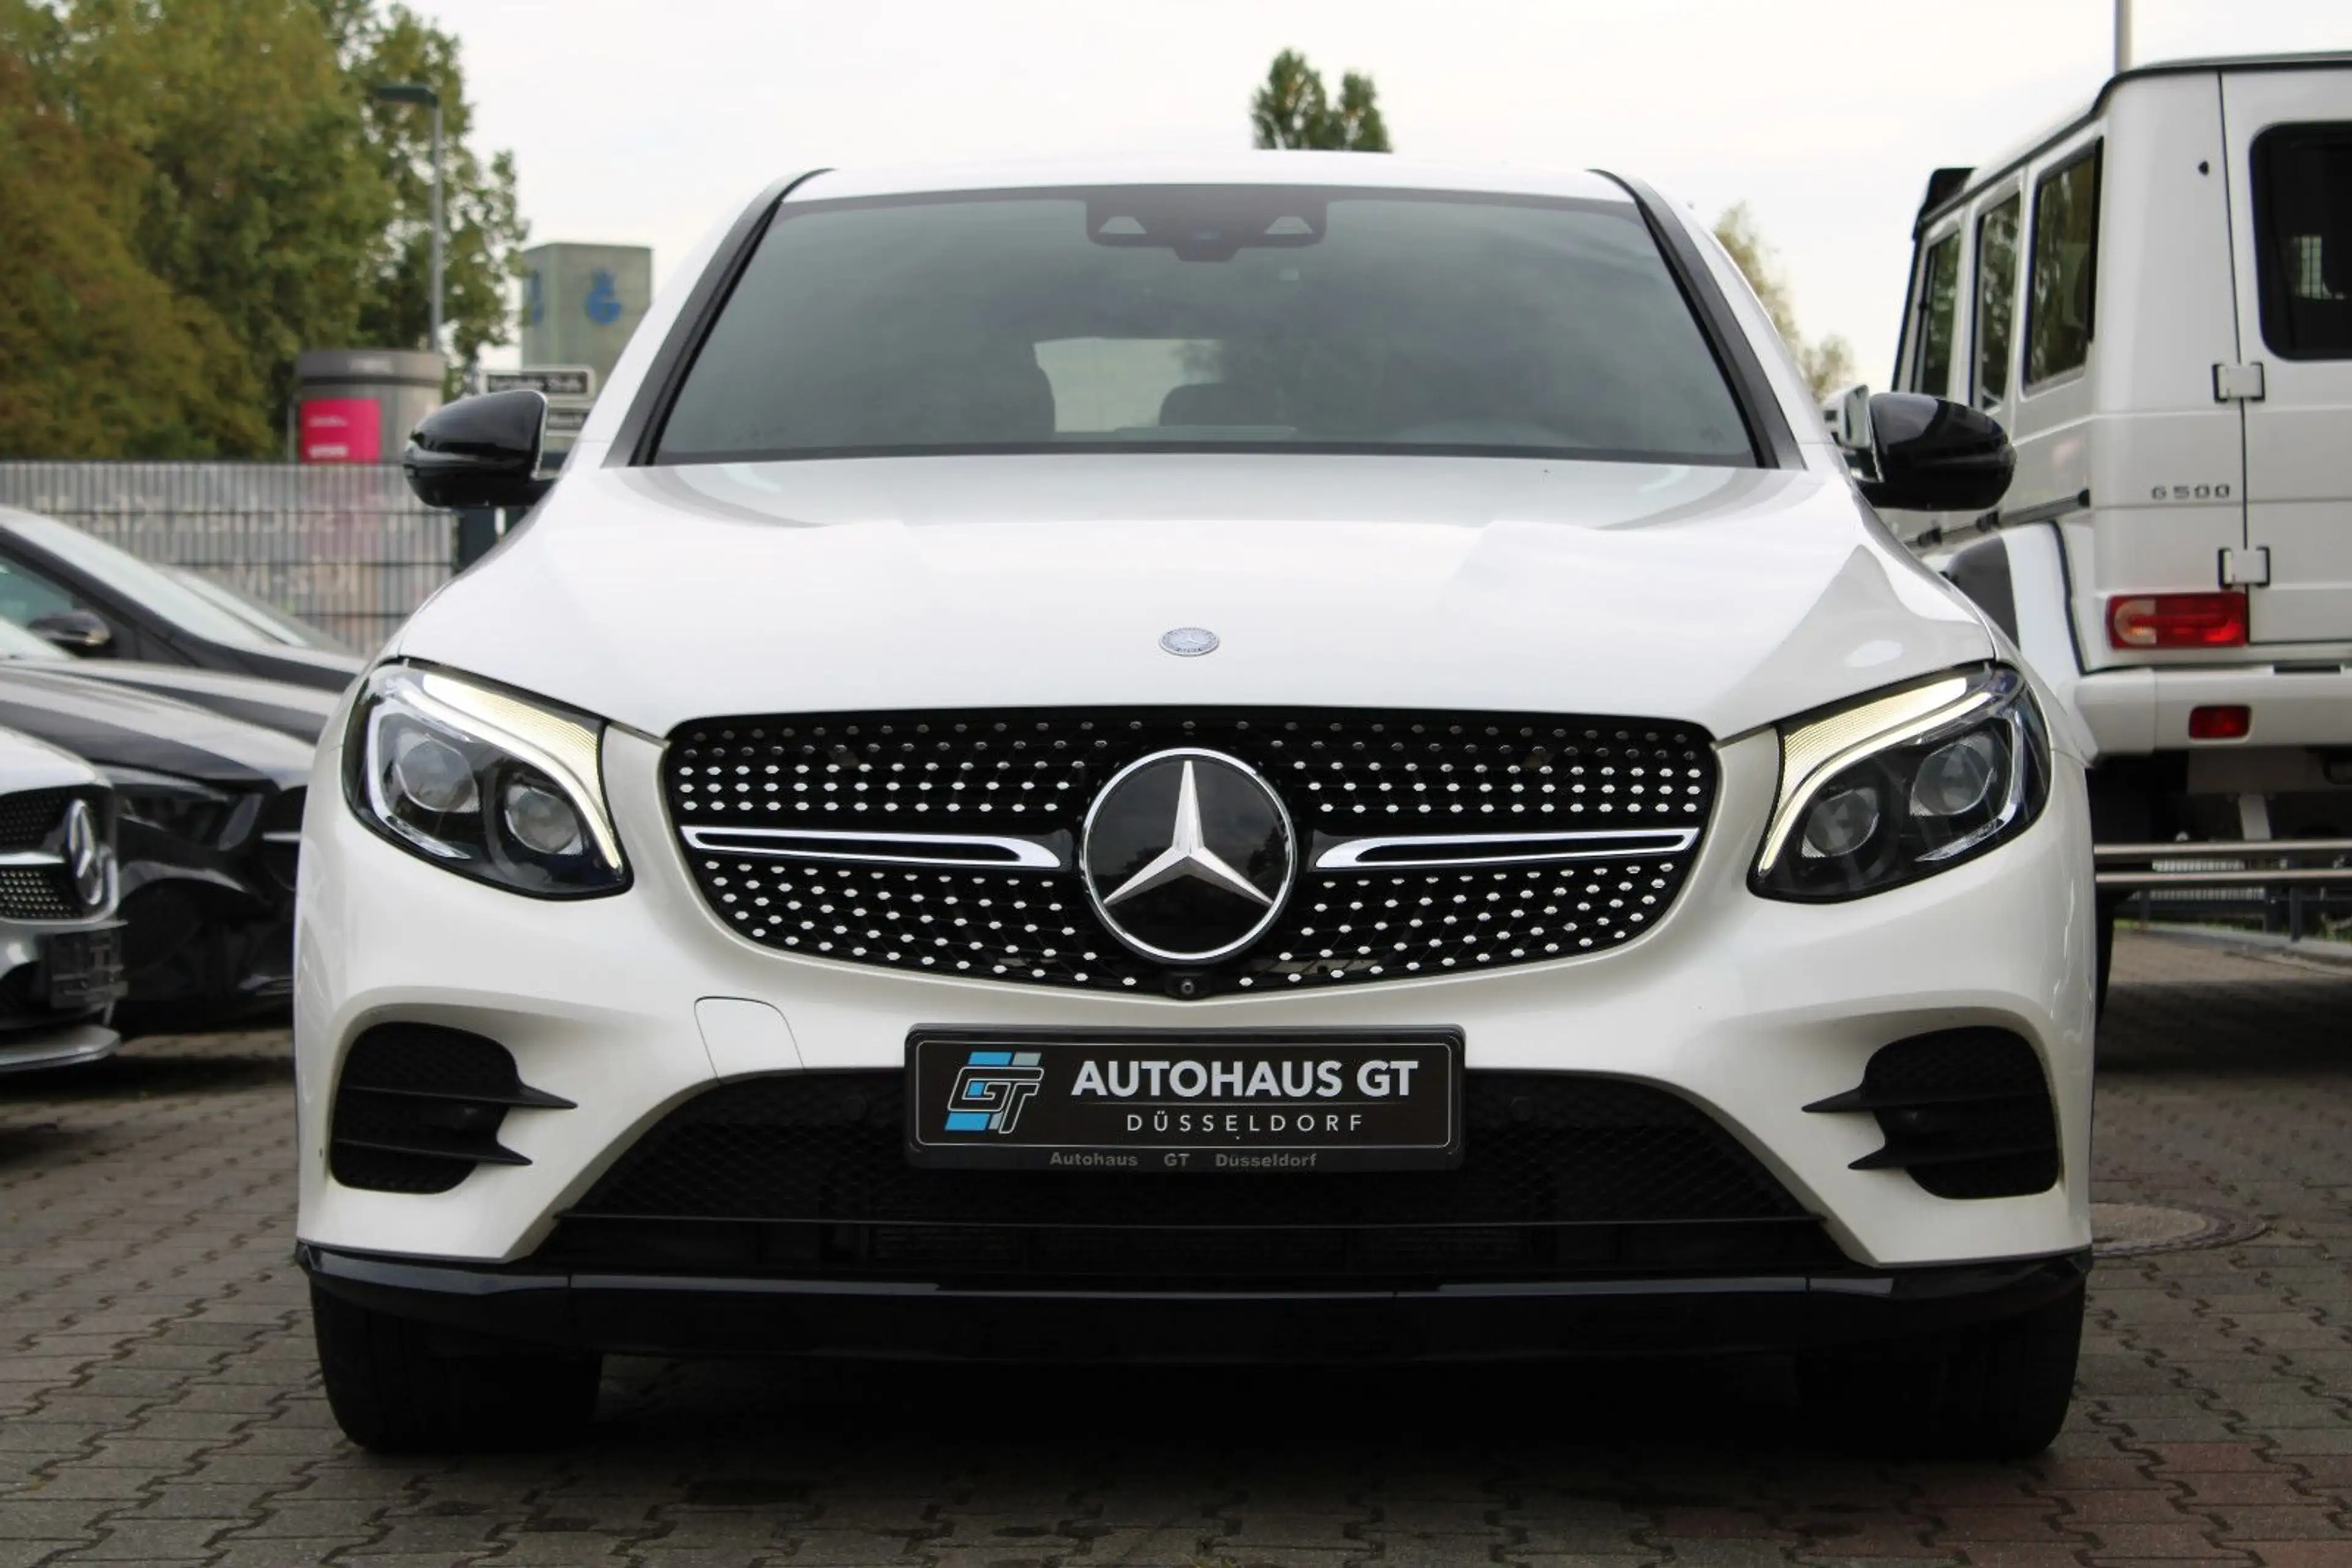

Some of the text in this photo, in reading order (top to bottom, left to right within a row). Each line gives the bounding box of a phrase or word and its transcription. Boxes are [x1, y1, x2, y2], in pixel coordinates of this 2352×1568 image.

[1071, 1060, 1419, 1097] AUTOHAUS GT
[1126, 1110, 1362, 1132] DÜSSELDORF
[1049, 1152, 1138, 1166] Autohaus
[1164, 1153, 1190, 1167] GT
